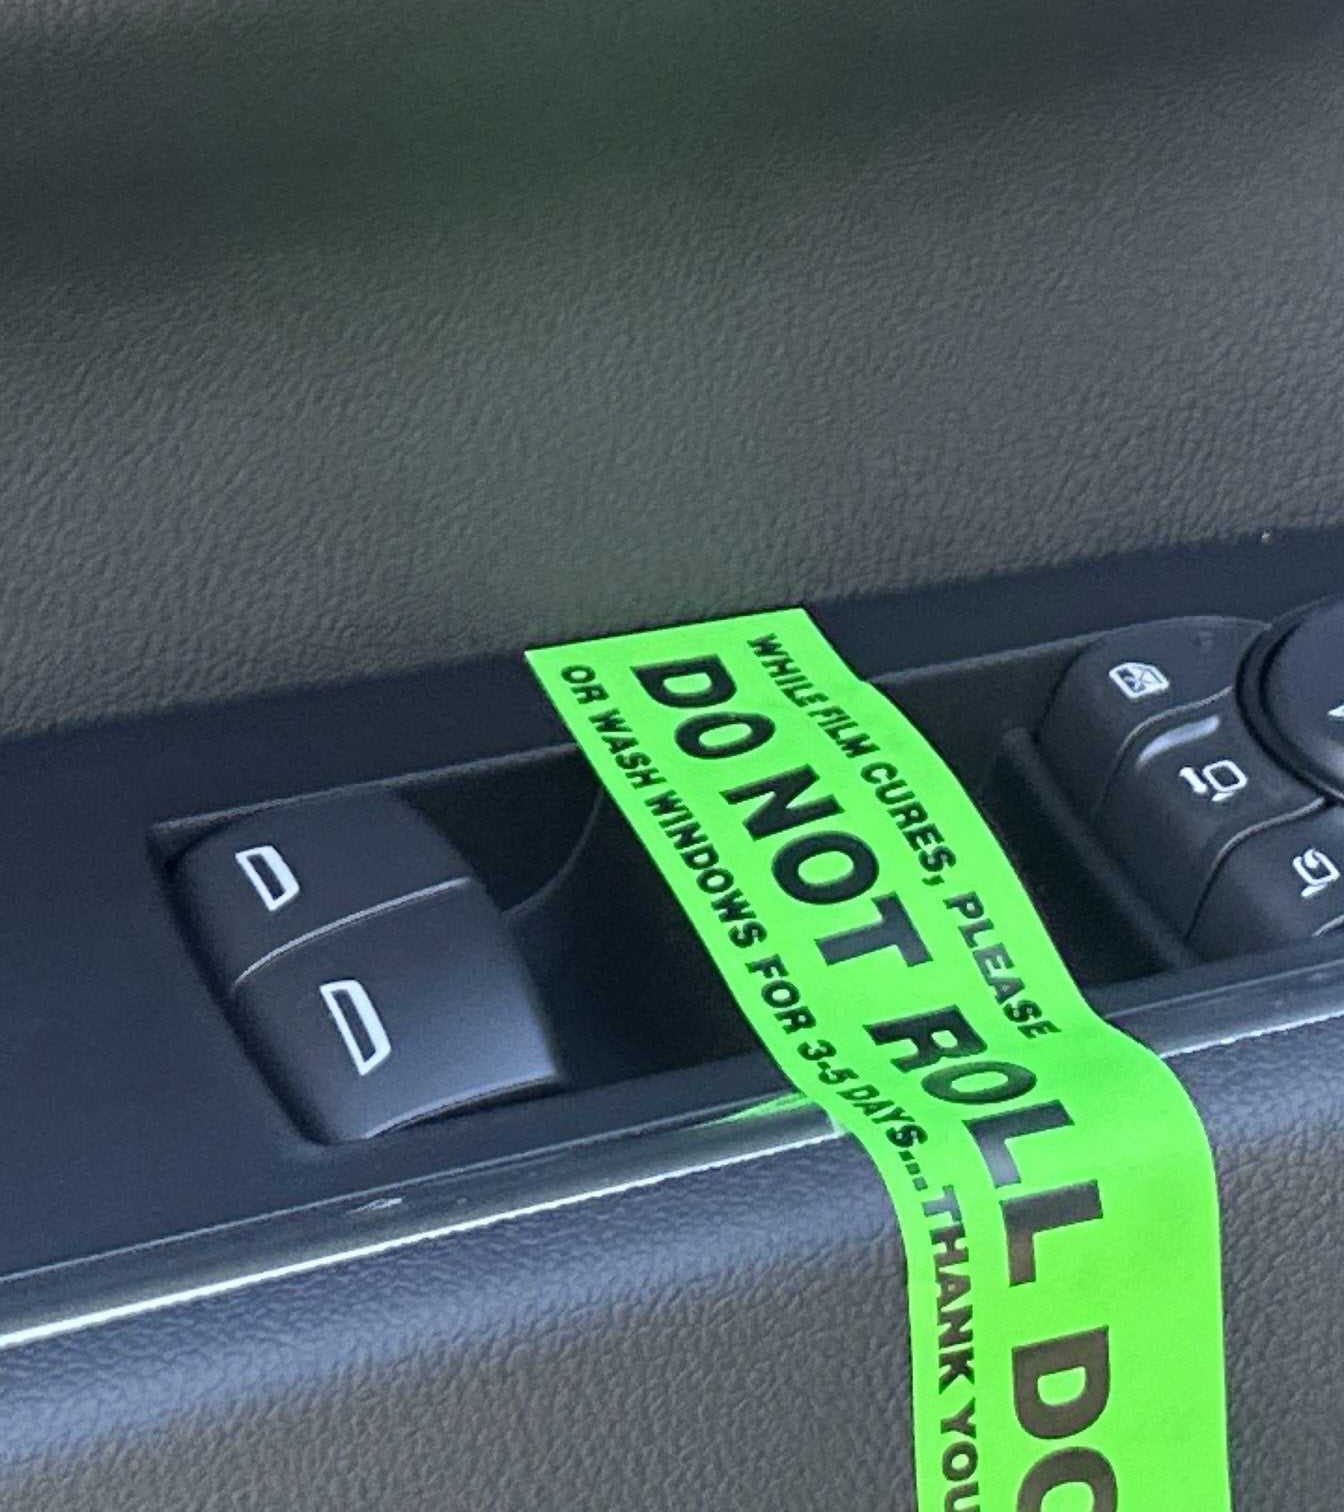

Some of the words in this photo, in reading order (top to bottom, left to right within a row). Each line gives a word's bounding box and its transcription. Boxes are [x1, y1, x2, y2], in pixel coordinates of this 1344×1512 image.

[560, 665, 609, 705] OR
[588, 708, 667, 789] WASH
[644, 789, 767, 948] WINDOWS
[744, 953, 816, 1034] FOR
[797, 1039, 859, 1085] 3-5
[940, 1397, 980, 1512] YOU
[630, 653, 776, 760] DO
[718, 763, 934, 967] NOT
[862, 1004, 1104, 1287] ROLL
[747, 633, 829, 708] WHILE
[808, 705, 880, 759] FILM
[860, 761, 956, 886] CURES,
[943, 891, 1062, 1039] PLEASE
